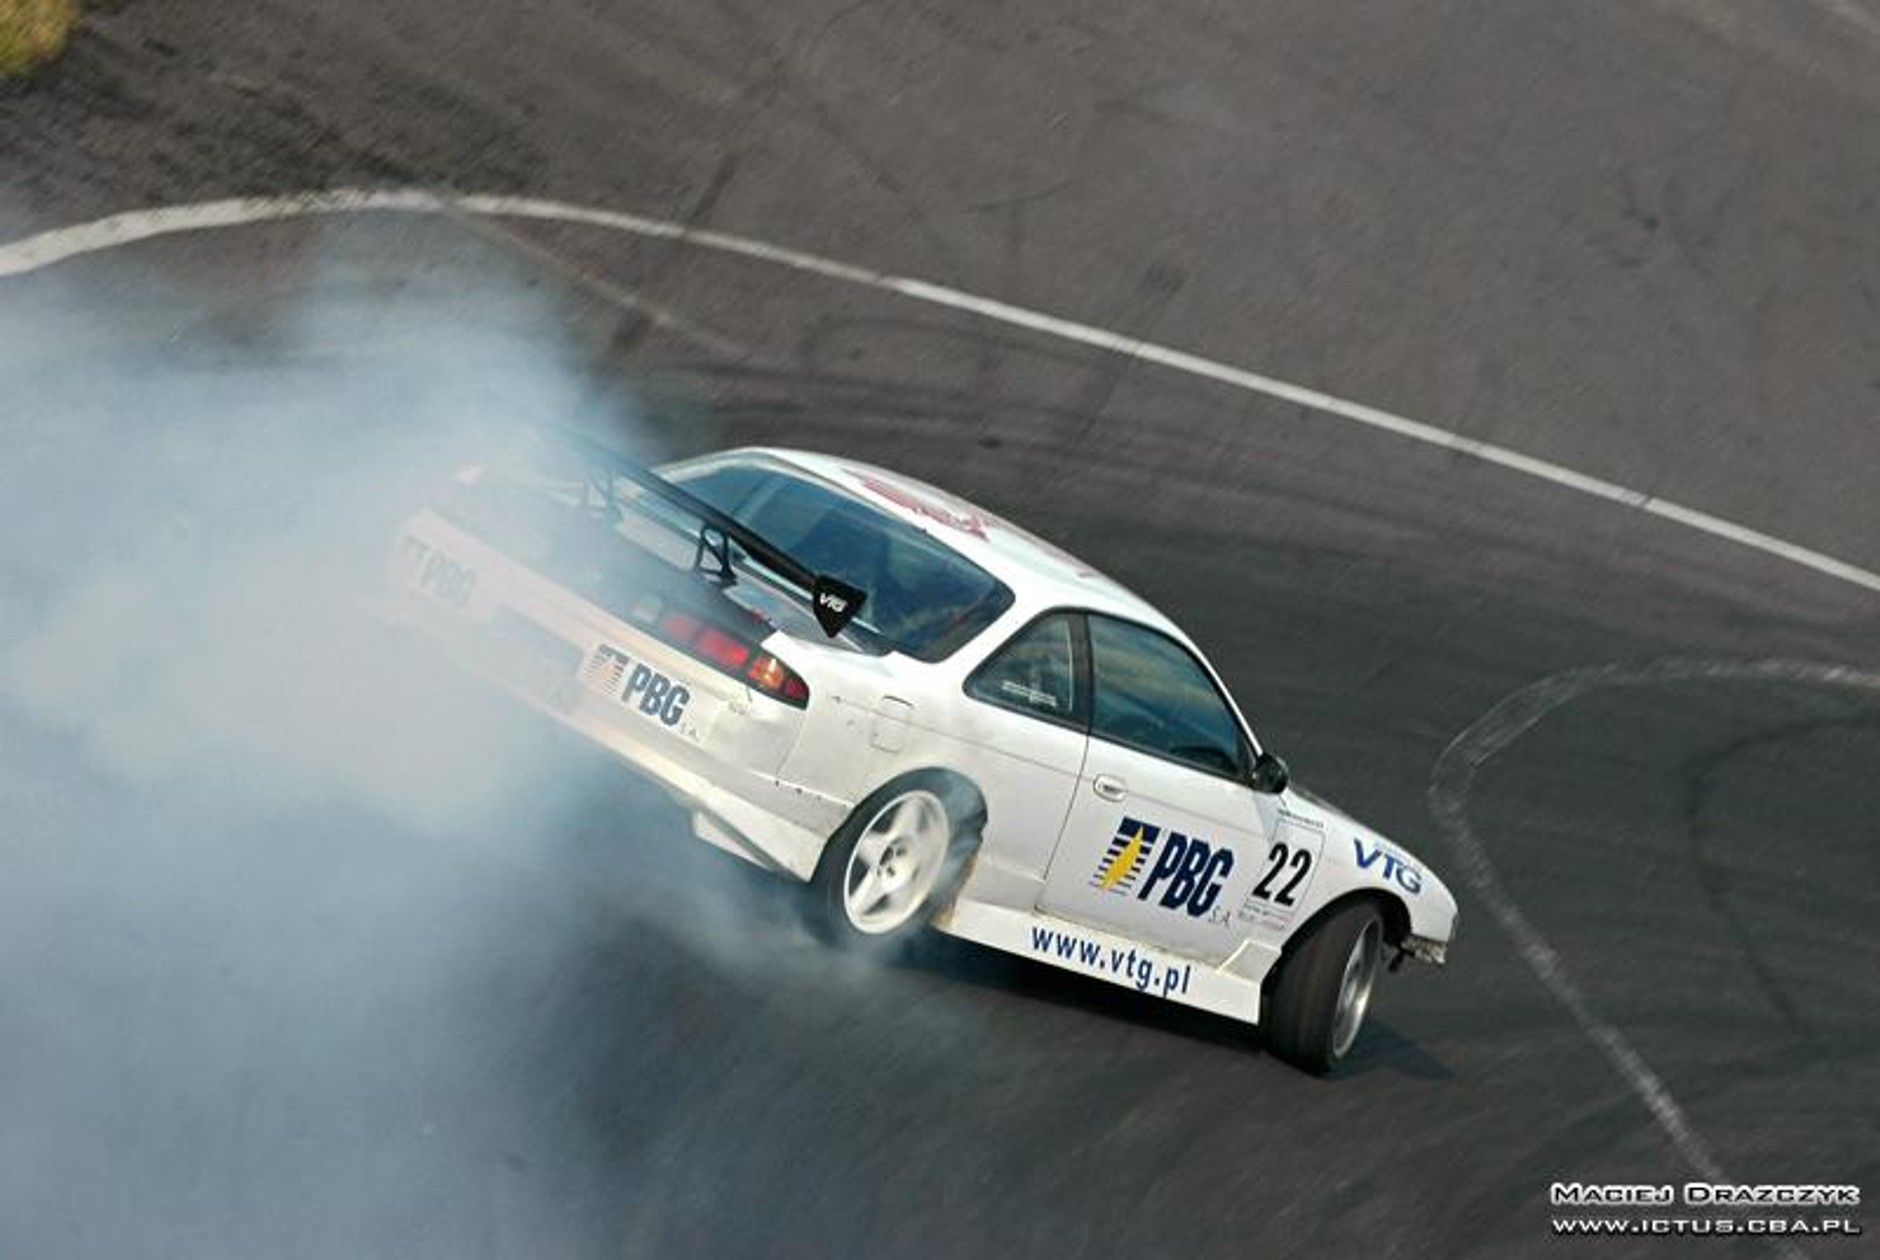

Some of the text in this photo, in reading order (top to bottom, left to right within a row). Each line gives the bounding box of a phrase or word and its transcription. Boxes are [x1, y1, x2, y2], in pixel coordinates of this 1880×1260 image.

[620, 662, 691, 726] PBG
[1137, 831, 1235, 919] PBG
[1252, 841, 1312, 907] 22
[1353, 836, 1423, 895] VTG
[1031, 925, 1191, 999] www.vtg.pl
